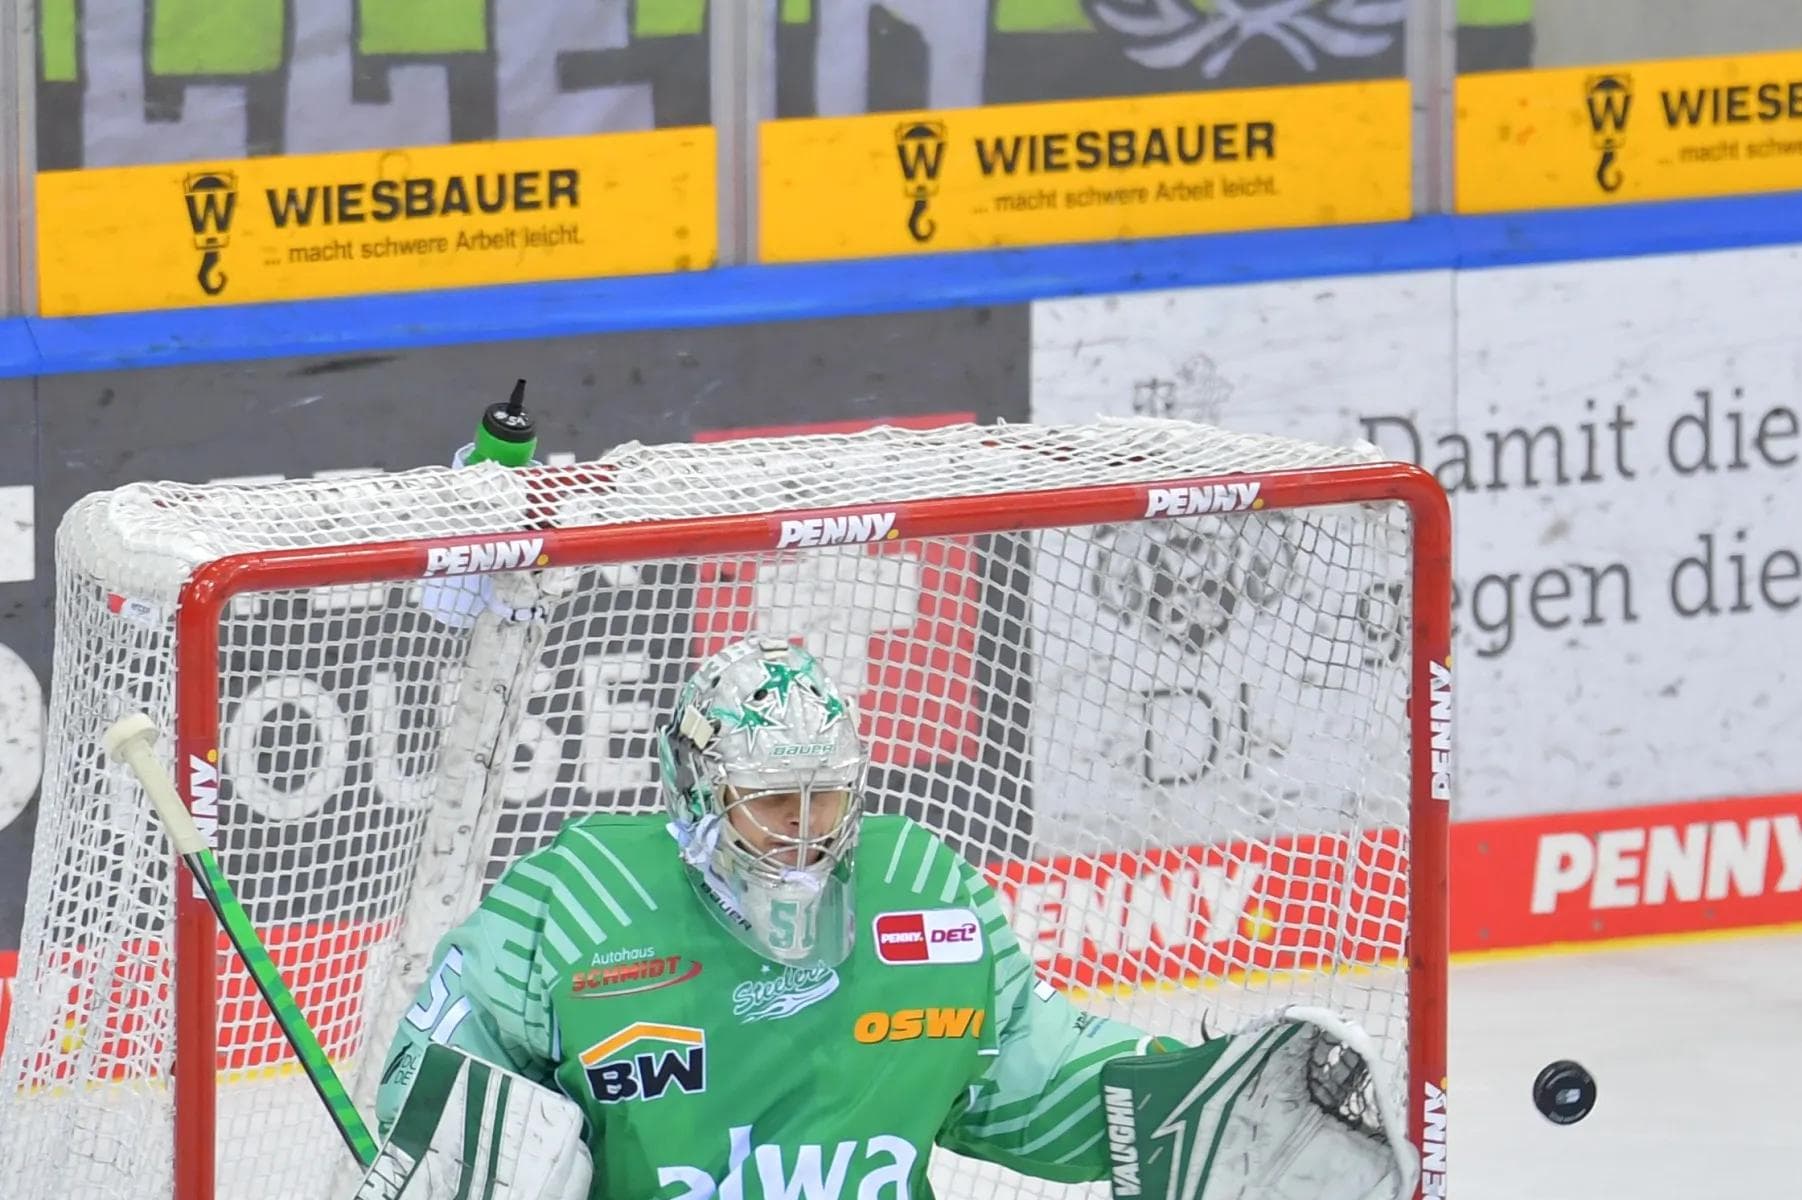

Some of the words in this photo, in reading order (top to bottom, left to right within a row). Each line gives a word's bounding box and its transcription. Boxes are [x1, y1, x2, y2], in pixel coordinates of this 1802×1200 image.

[974, 120, 1277, 177] WIESBAUER
[265, 168, 582, 229] WIESBAUER
[994, 188, 1059, 213] macht
[1064, 184, 1150, 209] schwere
[1155, 180, 1216, 203] Arbeit
[288, 239, 355, 264] macht
[360, 234, 449, 260] schwere
[455, 228, 517, 253] Arbeit
[1666, 389, 1801, 476] die
[590, 946, 656, 967] Autohaus
[929, 922, 977, 945] DEL
[571, 954, 682, 993] SCHMIDT
[585, 1047, 705, 1104] BW
[1104, 1083, 1143, 1198] VAUGHN
